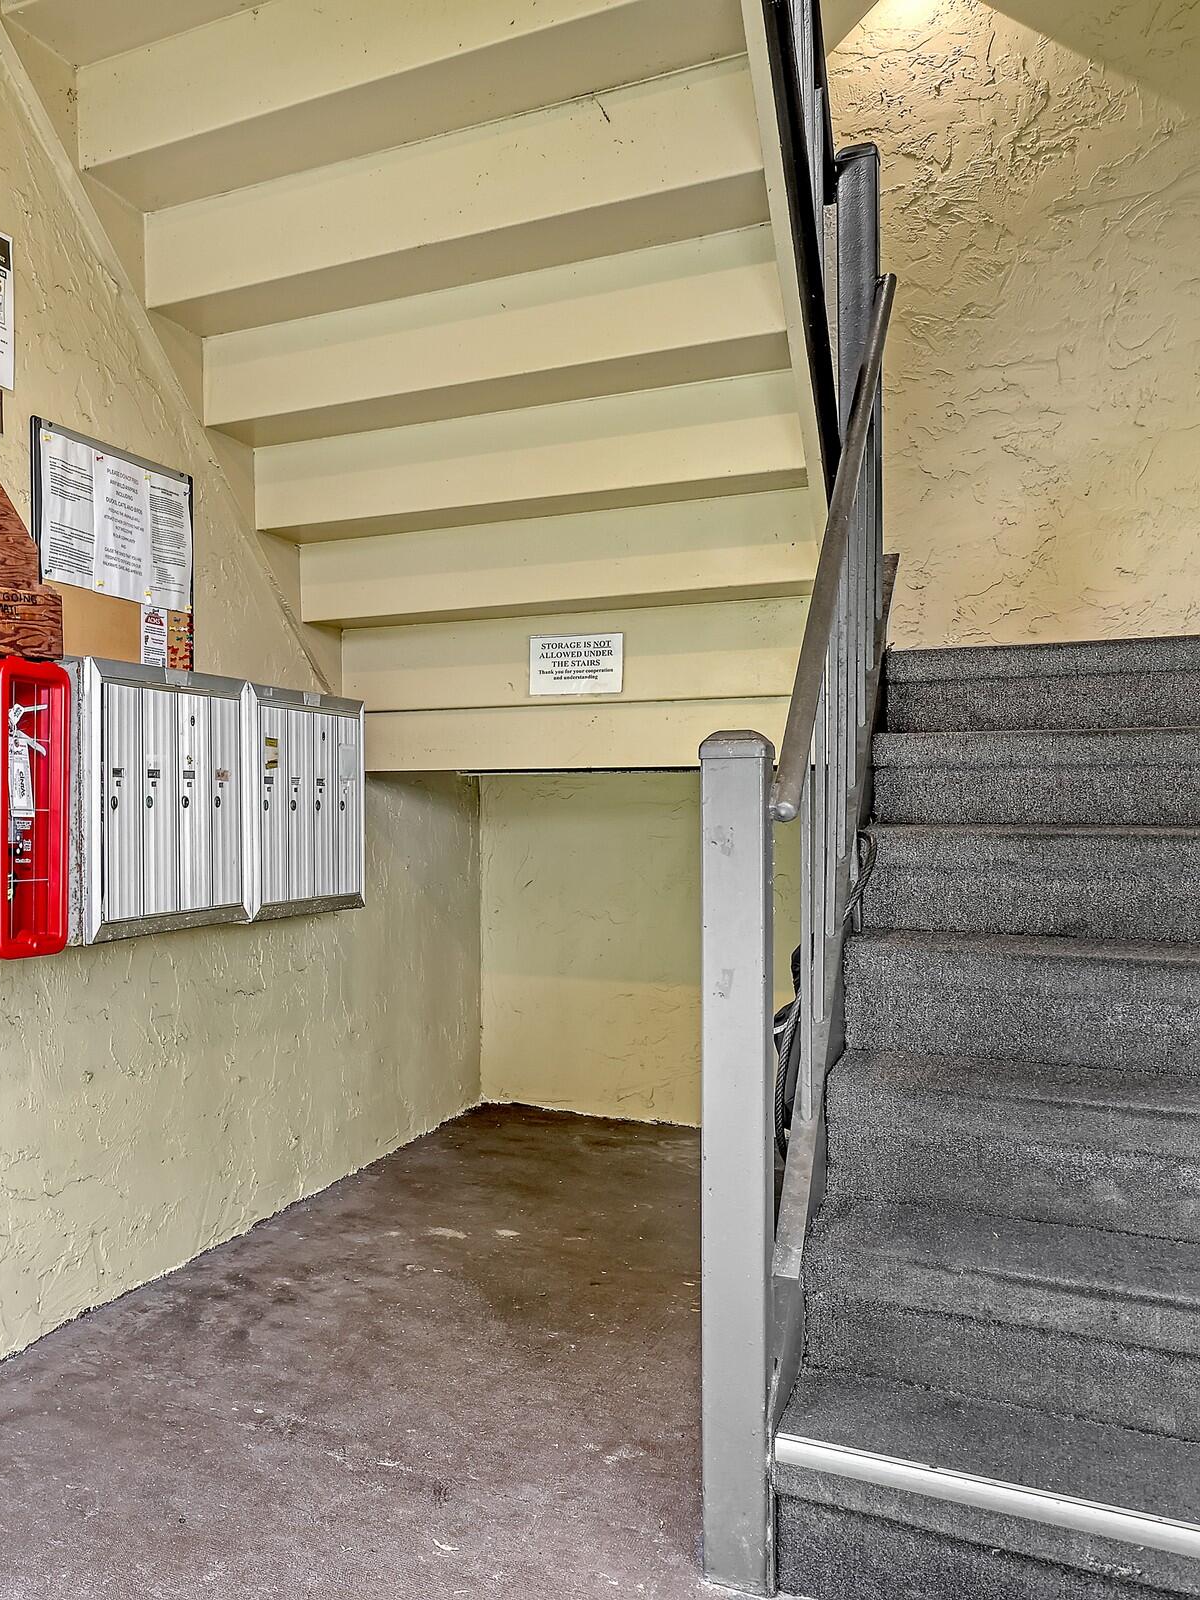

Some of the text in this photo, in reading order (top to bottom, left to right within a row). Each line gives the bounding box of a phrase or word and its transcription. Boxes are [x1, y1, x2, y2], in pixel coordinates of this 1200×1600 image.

[541, 641, 582, 650] STORAGE
[593, 640, 611, 648] NOT
[539, 650, 613, 659] ALLOWED UNDER
[571, 659, 601, 667] STAIRS
